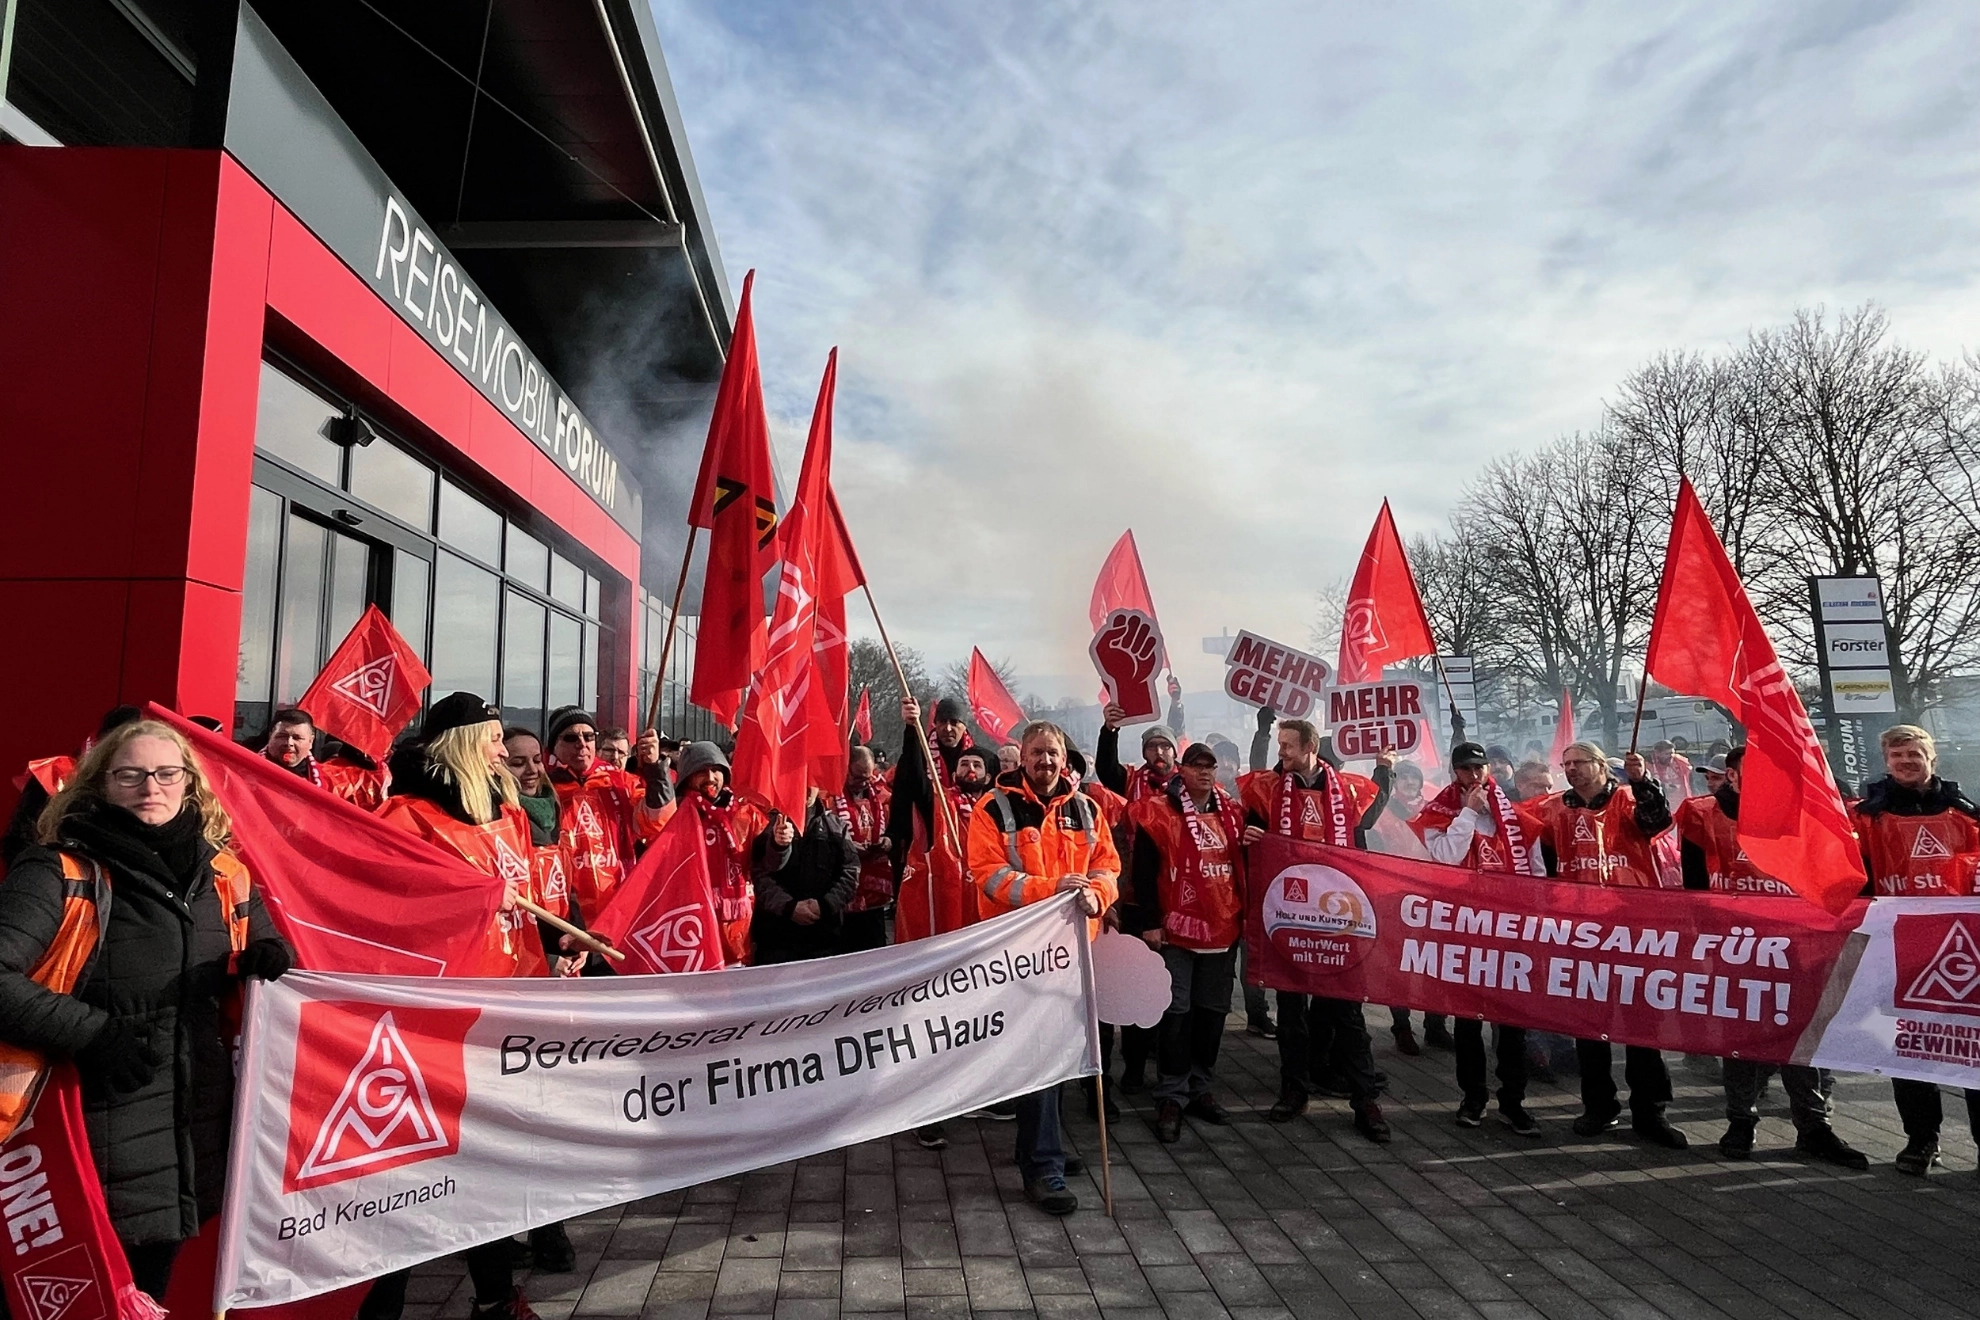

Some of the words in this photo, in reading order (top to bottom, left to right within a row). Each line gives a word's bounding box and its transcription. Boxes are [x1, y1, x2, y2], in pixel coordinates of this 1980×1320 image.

[554, 396, 618, 509] FORUM
[1233, 636, 1328, 692] MEHR
[1832, 640, 1884, 652] Forster
[1230, 667, 1311, 717] GELD
[1330, 683, 1422, 723] MEHR
[1337, 719, 1417, 756] GELD
[1839, 719, 1859, 775] FORUM
[1288, 937, 1351, 953] MehrWert
[1293, 951, 1313, 963] mit
[1316, 953, 1346, 966] Tarif
[1400, 894, 1680, 957] GEMEINSAM
[1692, 926, 1791, 970] FÜR
[500, 1019, 757, 1076] Betriebsrat
[760, 1003, 839, 1037] und
[843, 942, 1071, 1018] Vertrauensleute
[1400, 938, 1533, 993] MEHR
[1546, 957, 1792, 1027] ENTGELT!
[622, 1075, 692, 1123] der
[706, 1052, 824, 1106] Firma
[834, 1023, 917, 1077] DFH
[924, 1010, 1005, 1055] Haus
[278, 1205, 326, 1241] Bad
[334, 1175, 456, 1227] Kreuznach
